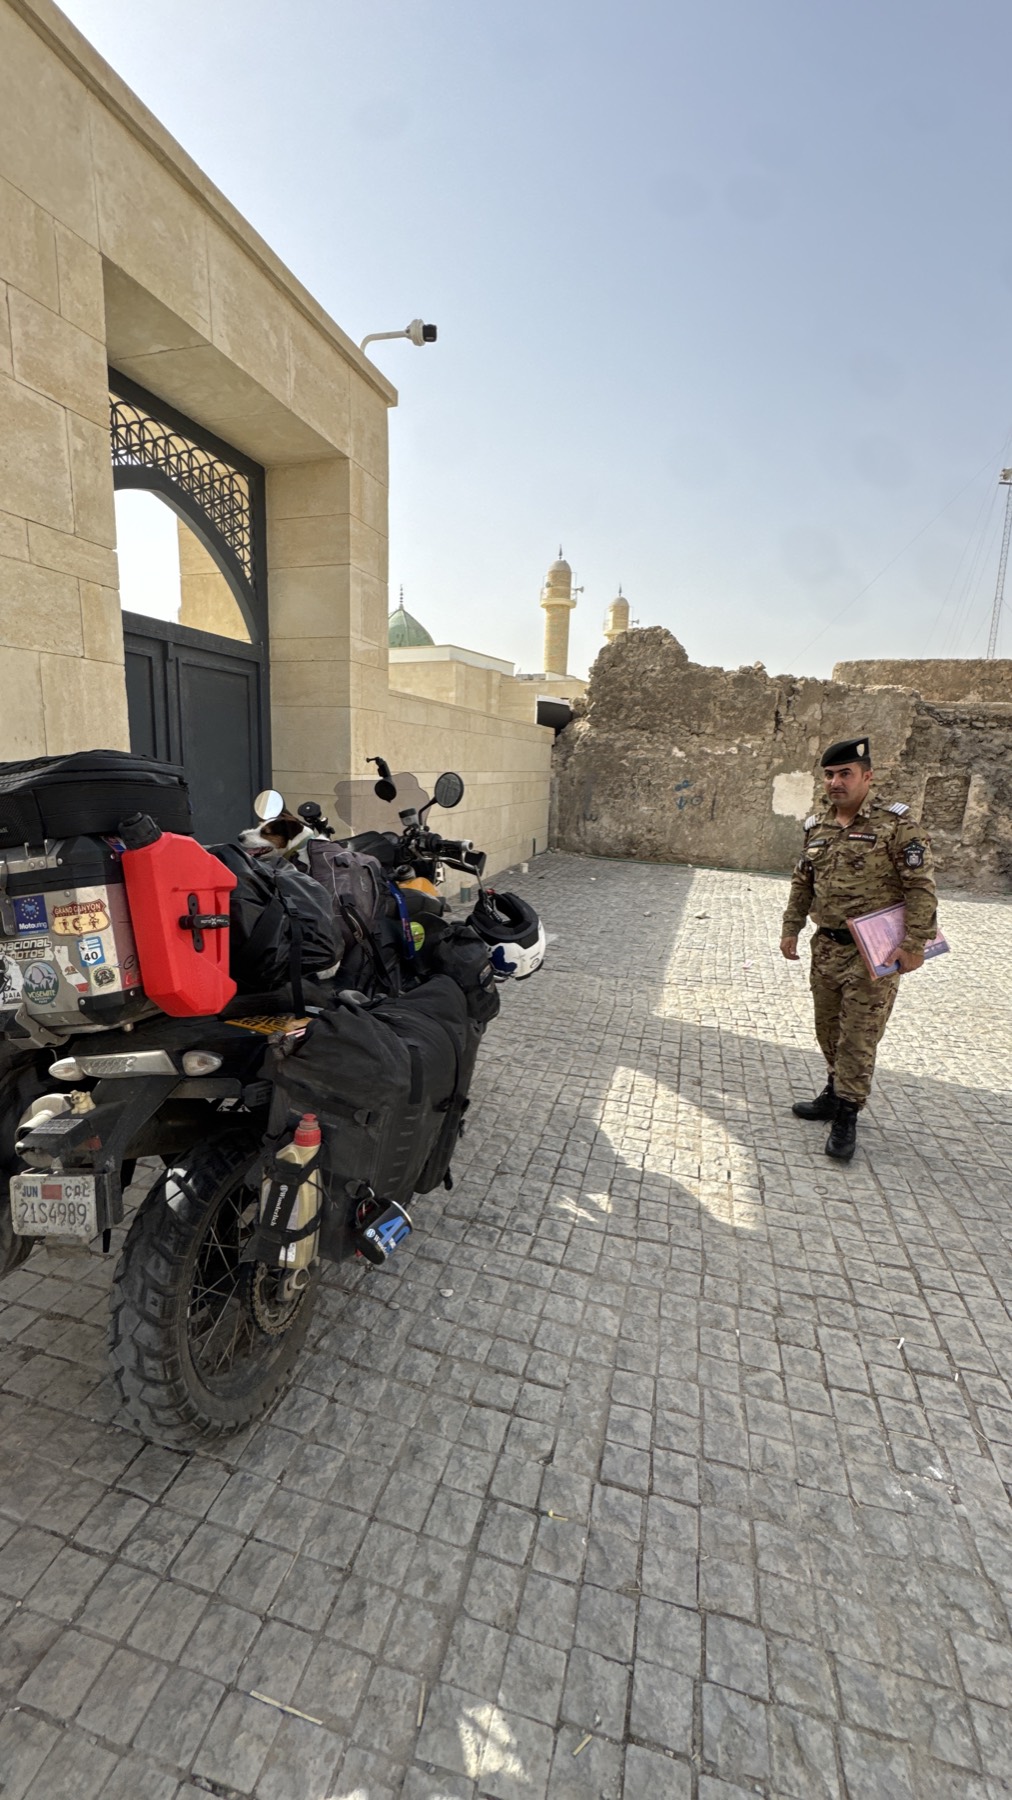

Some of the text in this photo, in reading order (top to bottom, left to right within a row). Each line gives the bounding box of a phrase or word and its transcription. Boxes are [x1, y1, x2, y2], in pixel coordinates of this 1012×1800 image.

[54, 906, 73, 915] GRAND
[73, 902, 101, 913] CANYON
[18, 922, 48, 930] Motouring
[84, 951, 99, 961] 40
[27, 990, 56, 998] YOSEMITE
[22, 1184, 90, 1199] JUN CAL
[19, 1202, 87, 1226] 21S4989
[270, 1190, 287, 1227] Wunderlich
